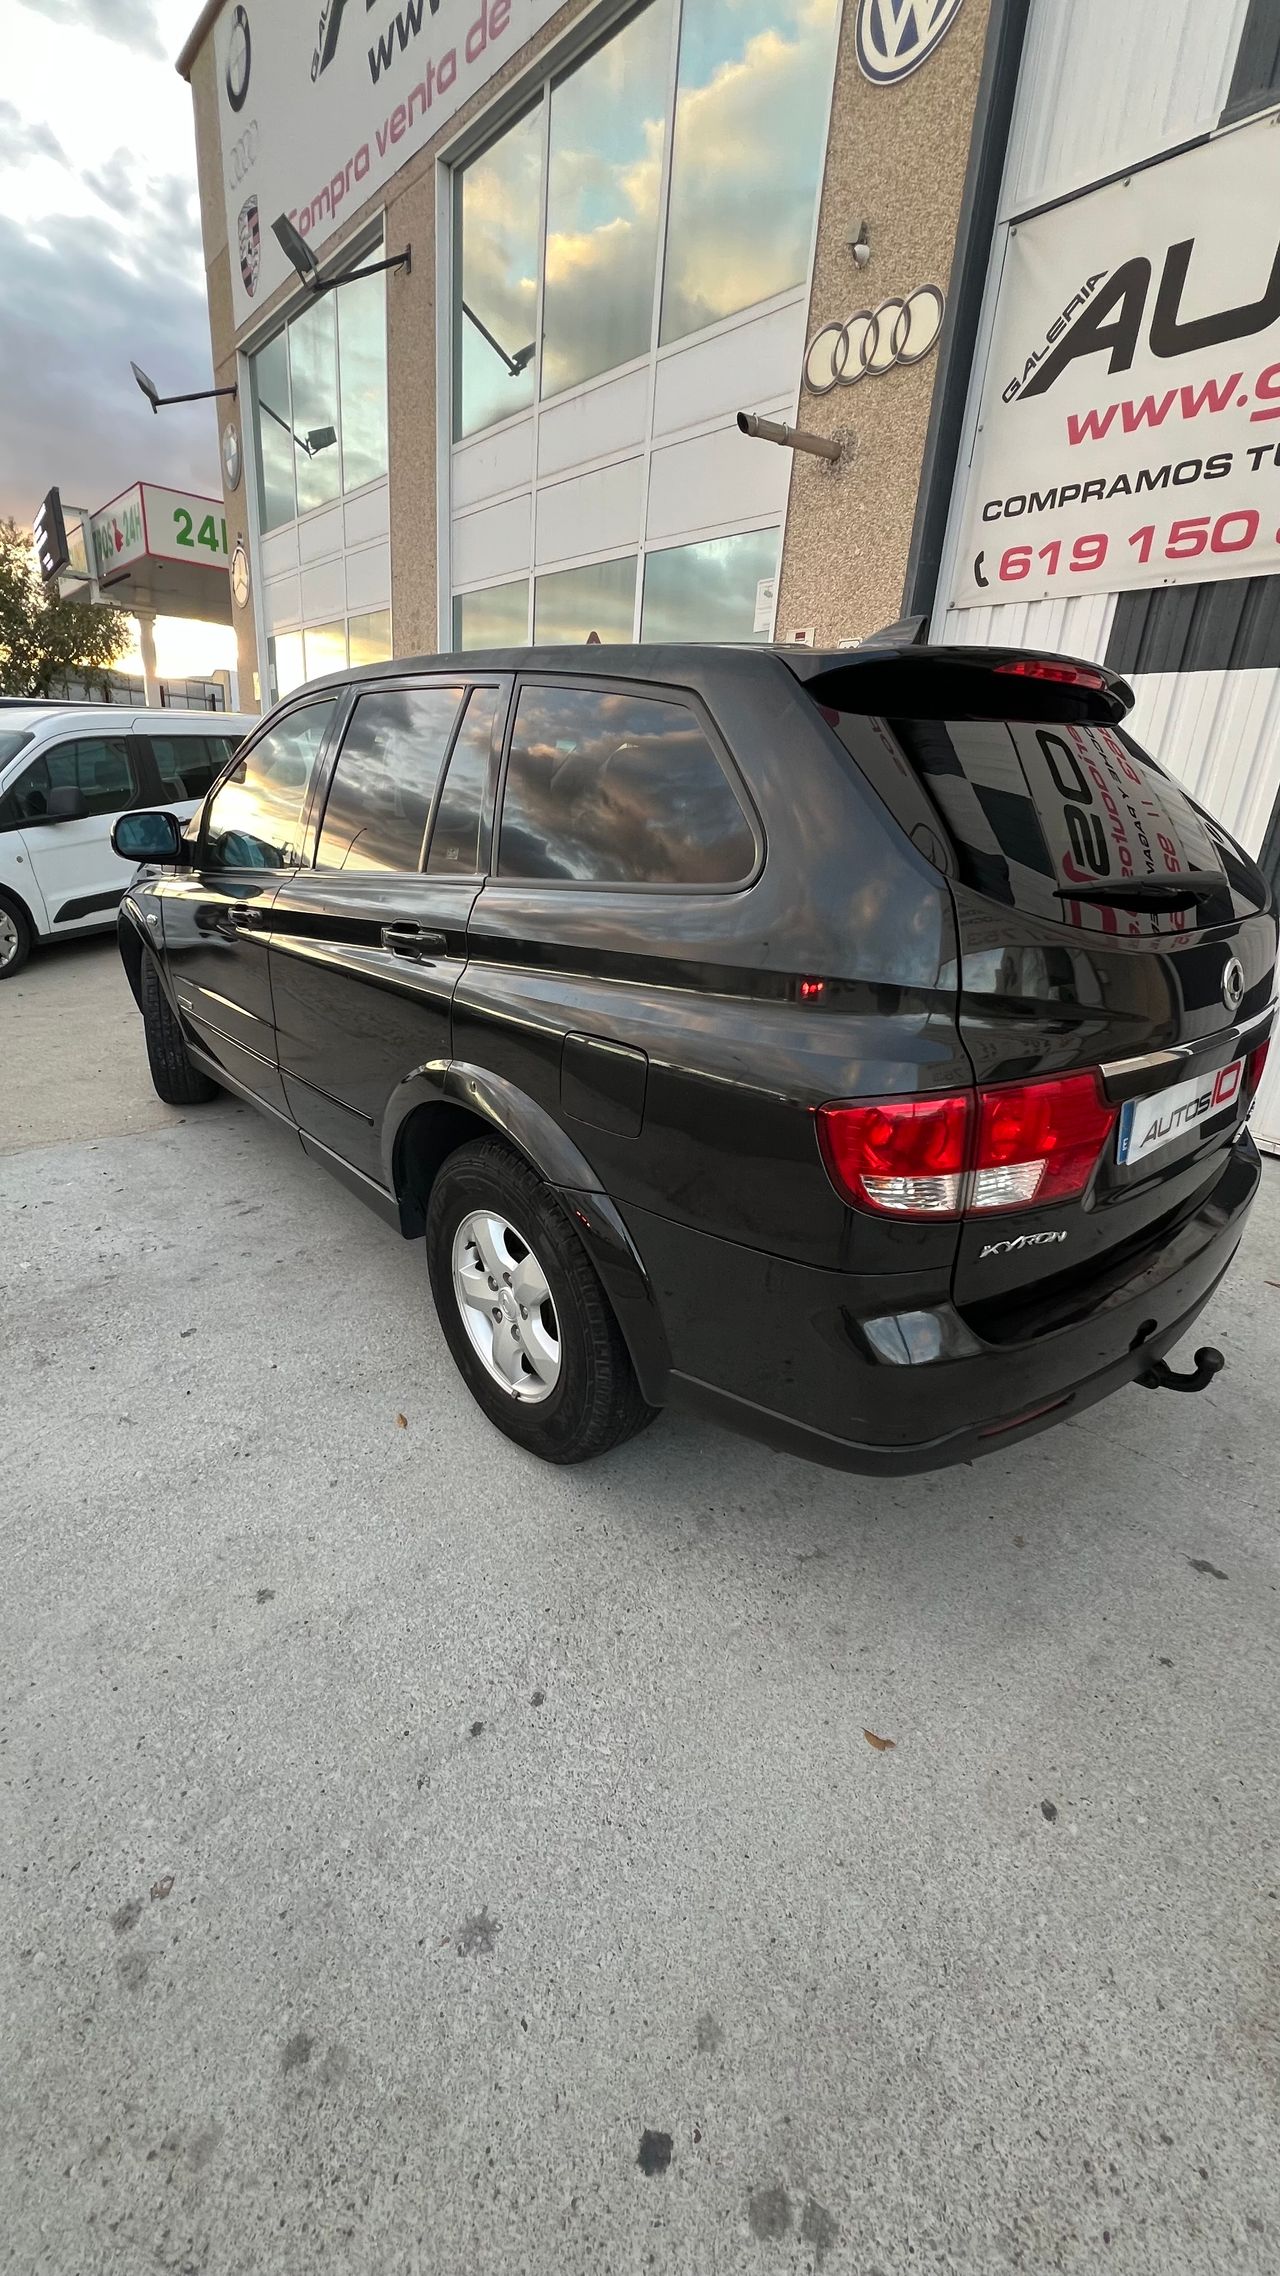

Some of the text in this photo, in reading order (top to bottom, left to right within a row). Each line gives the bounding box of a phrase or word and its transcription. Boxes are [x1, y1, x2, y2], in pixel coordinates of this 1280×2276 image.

[376, 48, 457, 158] venta
[465, 0, 512, 64] de
[1001, 270, 1109, 405] GALERIA
[982, 443, 1280, 523] COMPRAMOS T
[998, 533, 1109, 582] 619
[1128, 509, 1260, 564] 150
[979, 1230, 1068, 1258] KYRON
